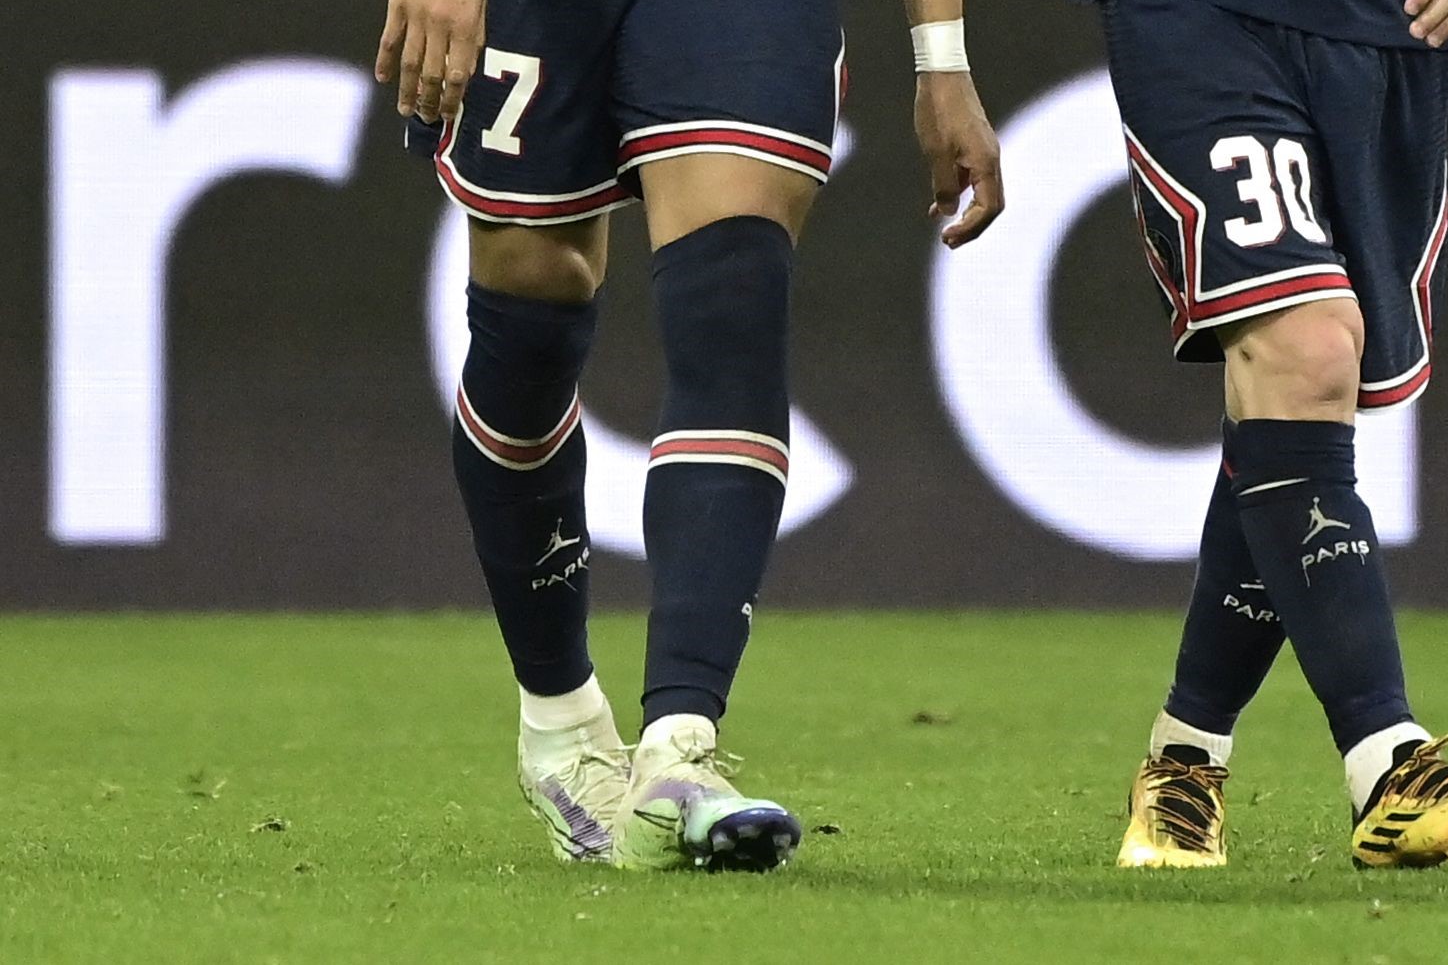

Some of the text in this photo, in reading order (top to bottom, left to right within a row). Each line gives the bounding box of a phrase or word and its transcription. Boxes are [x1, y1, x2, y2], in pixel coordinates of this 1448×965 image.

[481, 47, 543, 156] 7
[1209, 136, 1329, 247] 30
[1301, 540, 1370, 582] PARIS
[1223, 594, 1281, 622] PAR
